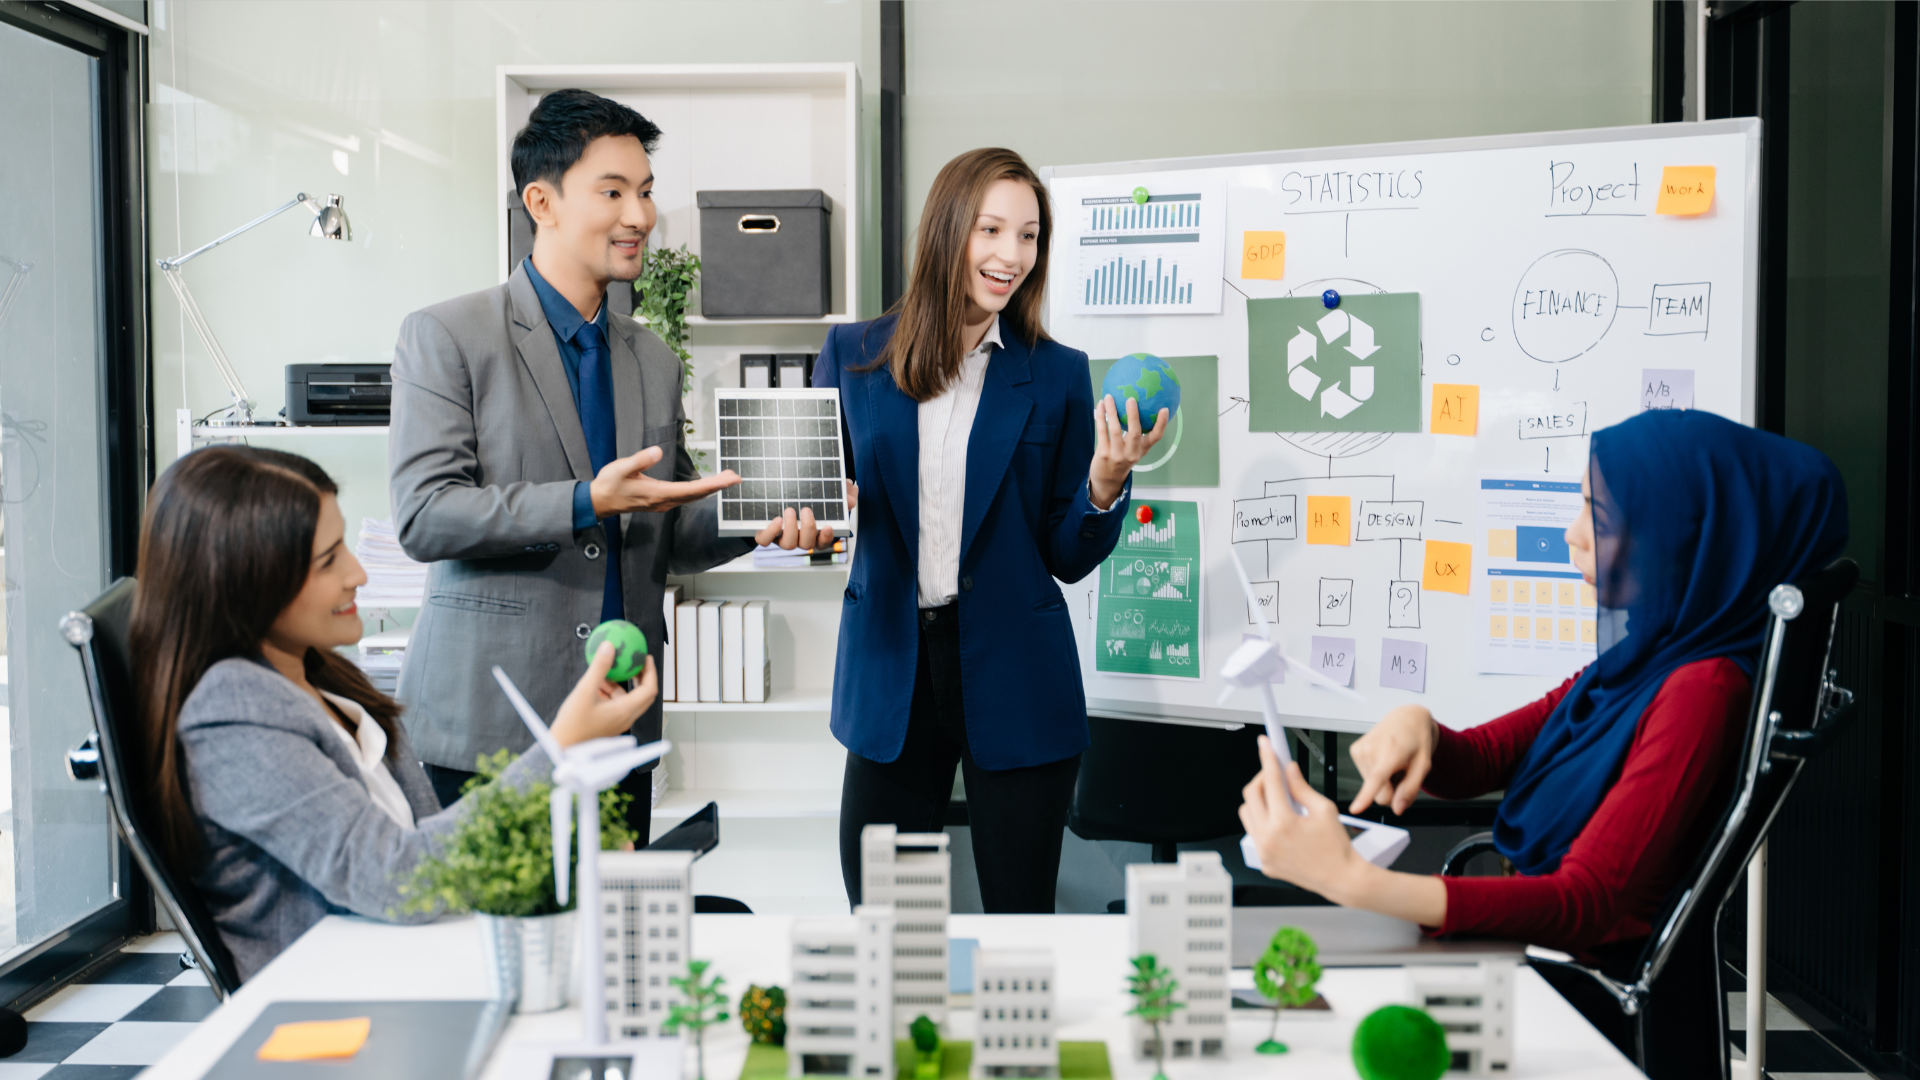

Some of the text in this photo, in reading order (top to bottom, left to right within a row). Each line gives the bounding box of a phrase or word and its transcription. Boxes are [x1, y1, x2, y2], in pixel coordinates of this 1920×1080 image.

[1282, 170, 1422, 205] STATISTICS
[1550, 160, 1640, 215] Project
[1247, 243, 1284, 262] GDP
[1523, 290, 1608, 320] FINANCE
[1655, 295, 1703, 317] TEAM
[1645, 380, 1670, 398] A/B
[1527, 414, 1575, 430] SALES
[1236, 508, 1292, 528] Promotion
[1435, 561, 1460, 577] UX
[1257, 594, 1273, 606] 00%
[1326, 591, 1348, 609] 20%
[1397, 587, 1412, 617] ?
